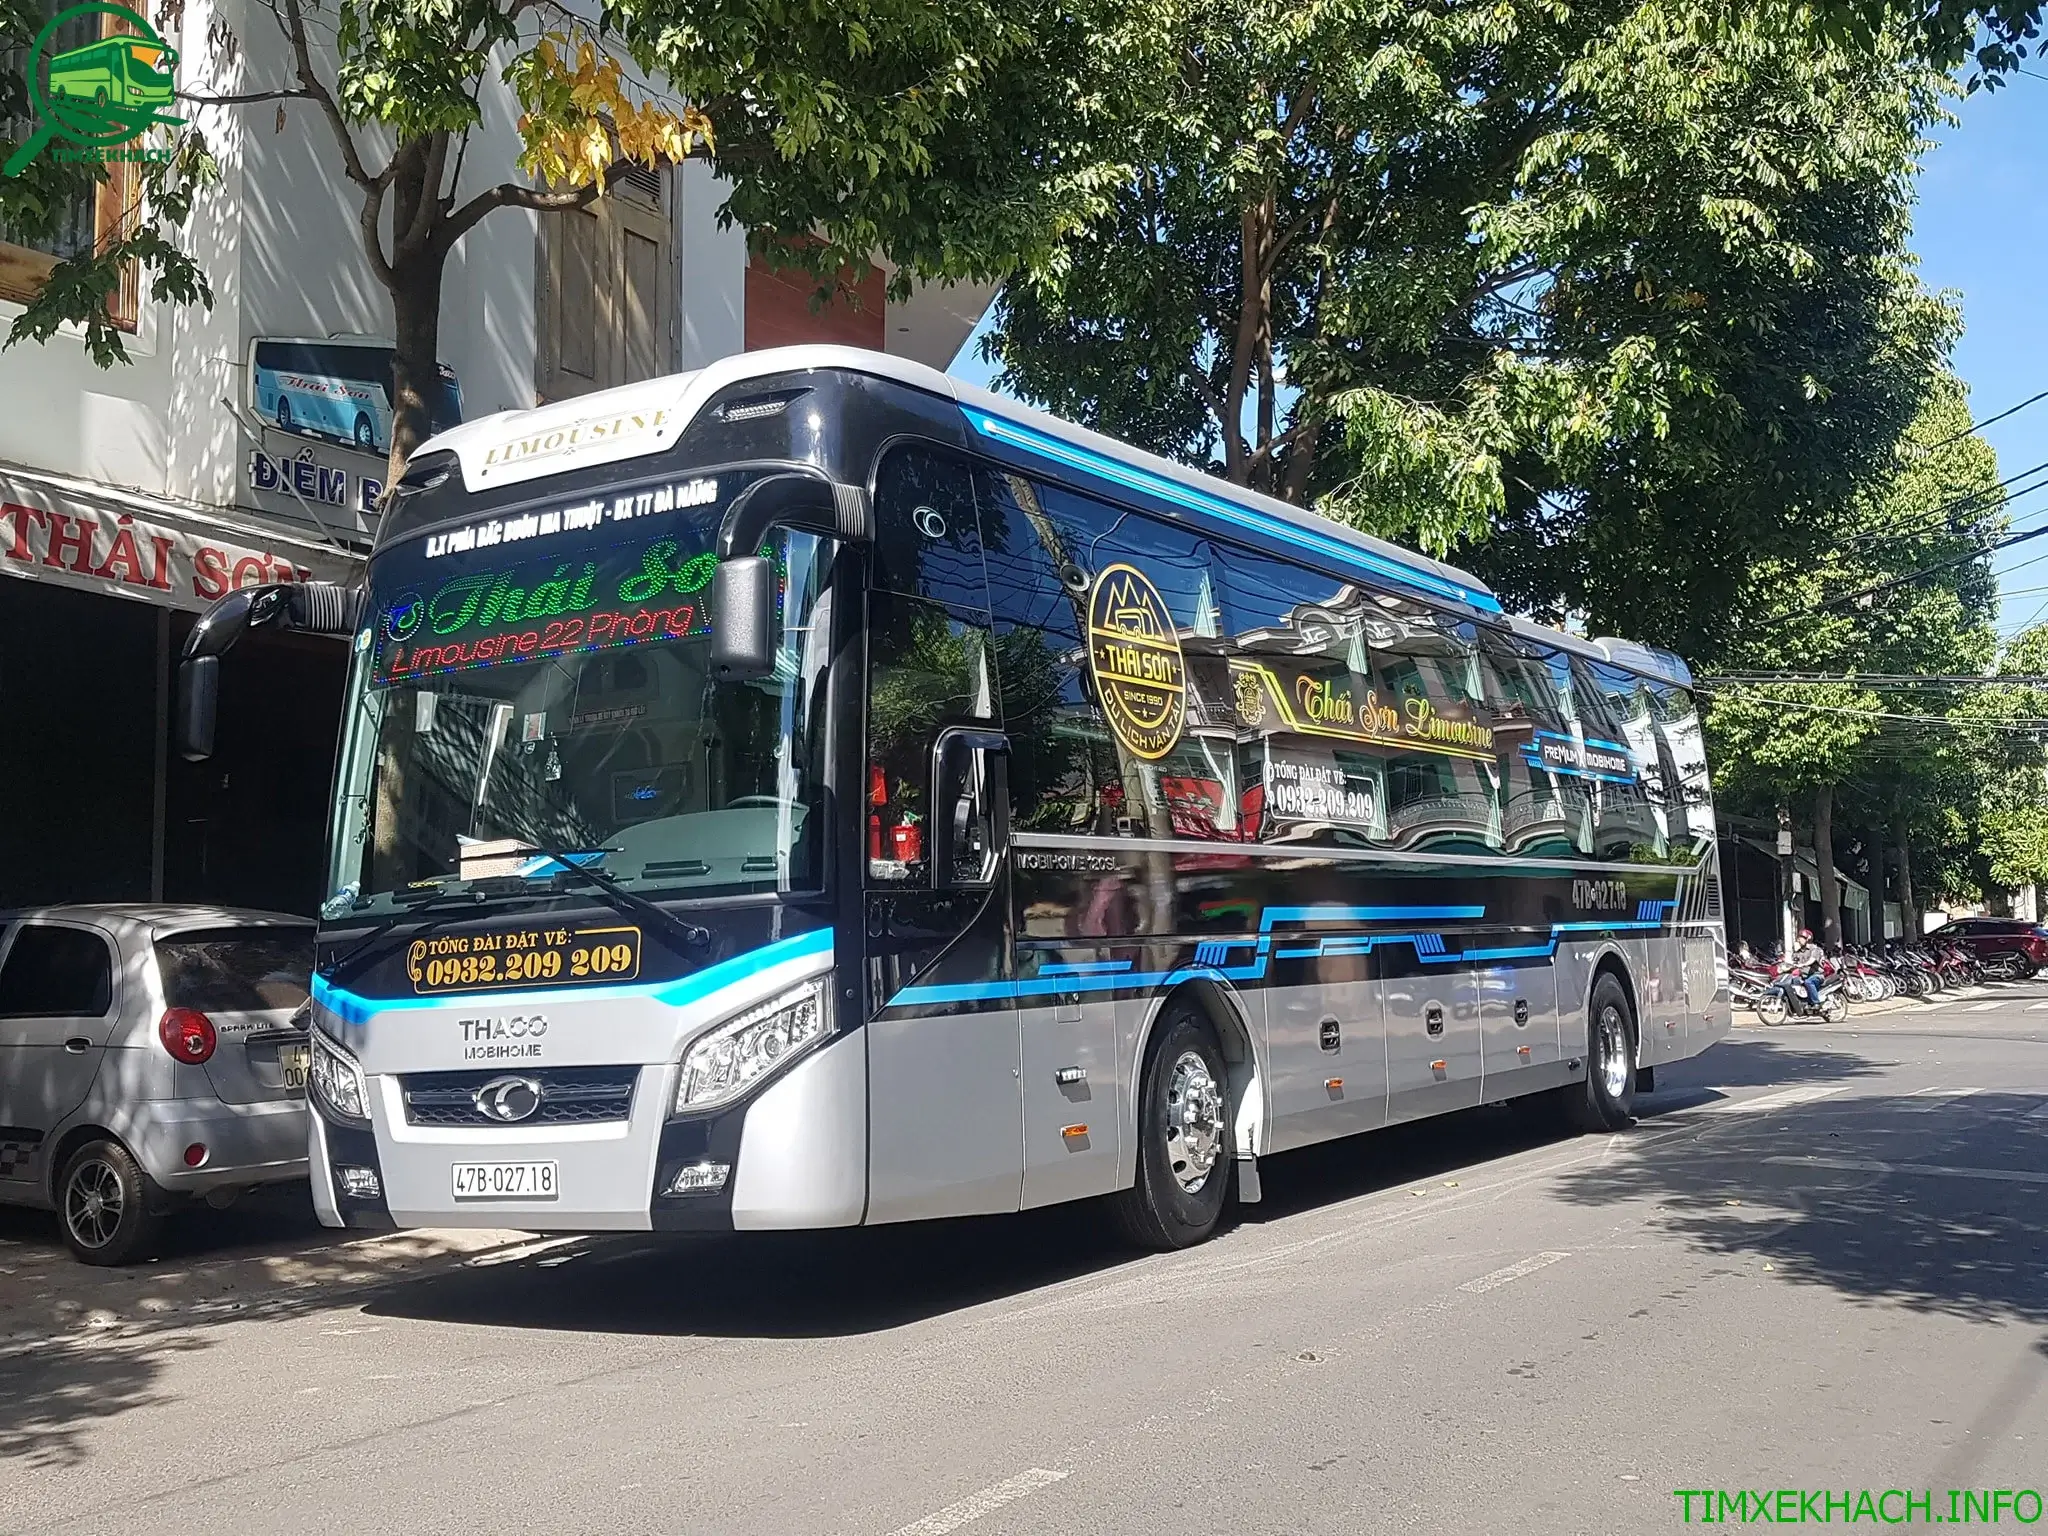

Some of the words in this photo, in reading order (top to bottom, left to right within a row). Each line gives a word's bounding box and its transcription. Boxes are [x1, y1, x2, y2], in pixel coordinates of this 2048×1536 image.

[485, 410, 670, 465] LIMOUSINE
[249, 446, 347, 506] ĐIỂM
[636, 493, 654, 517] TT
[0, 503, 175, 592] THÁI
[428, 560, 598, 635] Thái
[391, 629, 539, 673] Limousine
[539, 618, 585, 650] 22
[587, 606, 695, 642] Phòng
[1105, 643, 1141, 679] THÁI
[1123, 690, 1147, 704] SINCE
[1295, 675, 1355, 726] Thái
[1404, 698, 1493, 750] Limousine
[428, 935, 469, 955] TỔNG
[473, 932, 502, 951] ĐÀI
[506, 930, 539, 951] ĐẶT
[544, 927, 573, 946] VÉ:
[426, 950, 562, 987] 0932.209
[570, 944, 633, 978] 209
[458, 1015, 548, 1042] THACO
[464, 1043, 542, 1061] MOBIHOME
